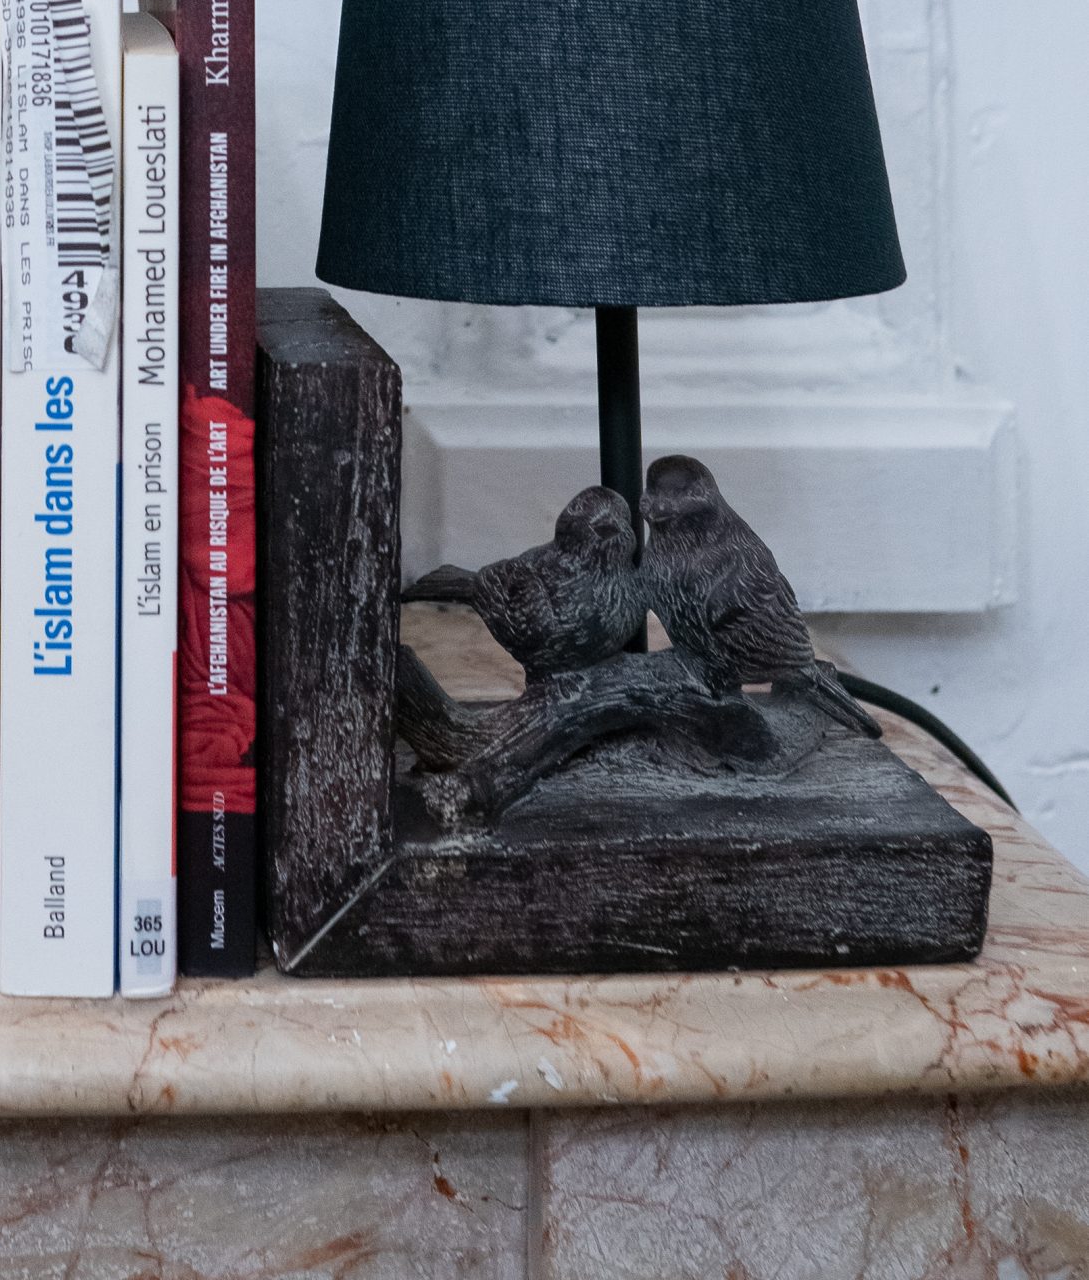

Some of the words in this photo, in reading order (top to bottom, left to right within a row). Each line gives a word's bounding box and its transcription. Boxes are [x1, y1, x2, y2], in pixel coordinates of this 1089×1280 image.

[17, 64, 28, 153] LISLAM
[138, 105, 167, 233] Loueslati
[210, 132, 228, 239] AFGHANISTAN
[19, 168, 30, 226] DANS
[20, 242, 31, 286] LES
[210, 244, 228, 260] IN
[210, 265, 228, 298] FIRE
[137, 248, 166, 386] Mohamed
[210, 303, 228, 354] UNDER
[210, 360, 228, 390] ART
[35, 376, 74, 430] les
[138, 423, 167, 494] prison
[207, 420, 227, 462] L'ART
[34, 443, 74, 535] dans
[210, 467, 227, 487] DE
[144, 504, 162, 532] en
[210, 490, 229, 546] RISQUE
[138, 541, 162, 617] L'islam
[210, 551, 228, 572] AU
[33, 548, 73, 675] L'islam
[207, 576, 228, 696] L'AFGHANISTAN
[213, 791, 225, 822] SUD
[213, 824, 225, 871] ACTES
[43, 856, 65, 939] Balland
[134, 915, 163, 932] 365
[211, 889, 224, 949] Mucem
[130, 940, 165, 956] LOU
